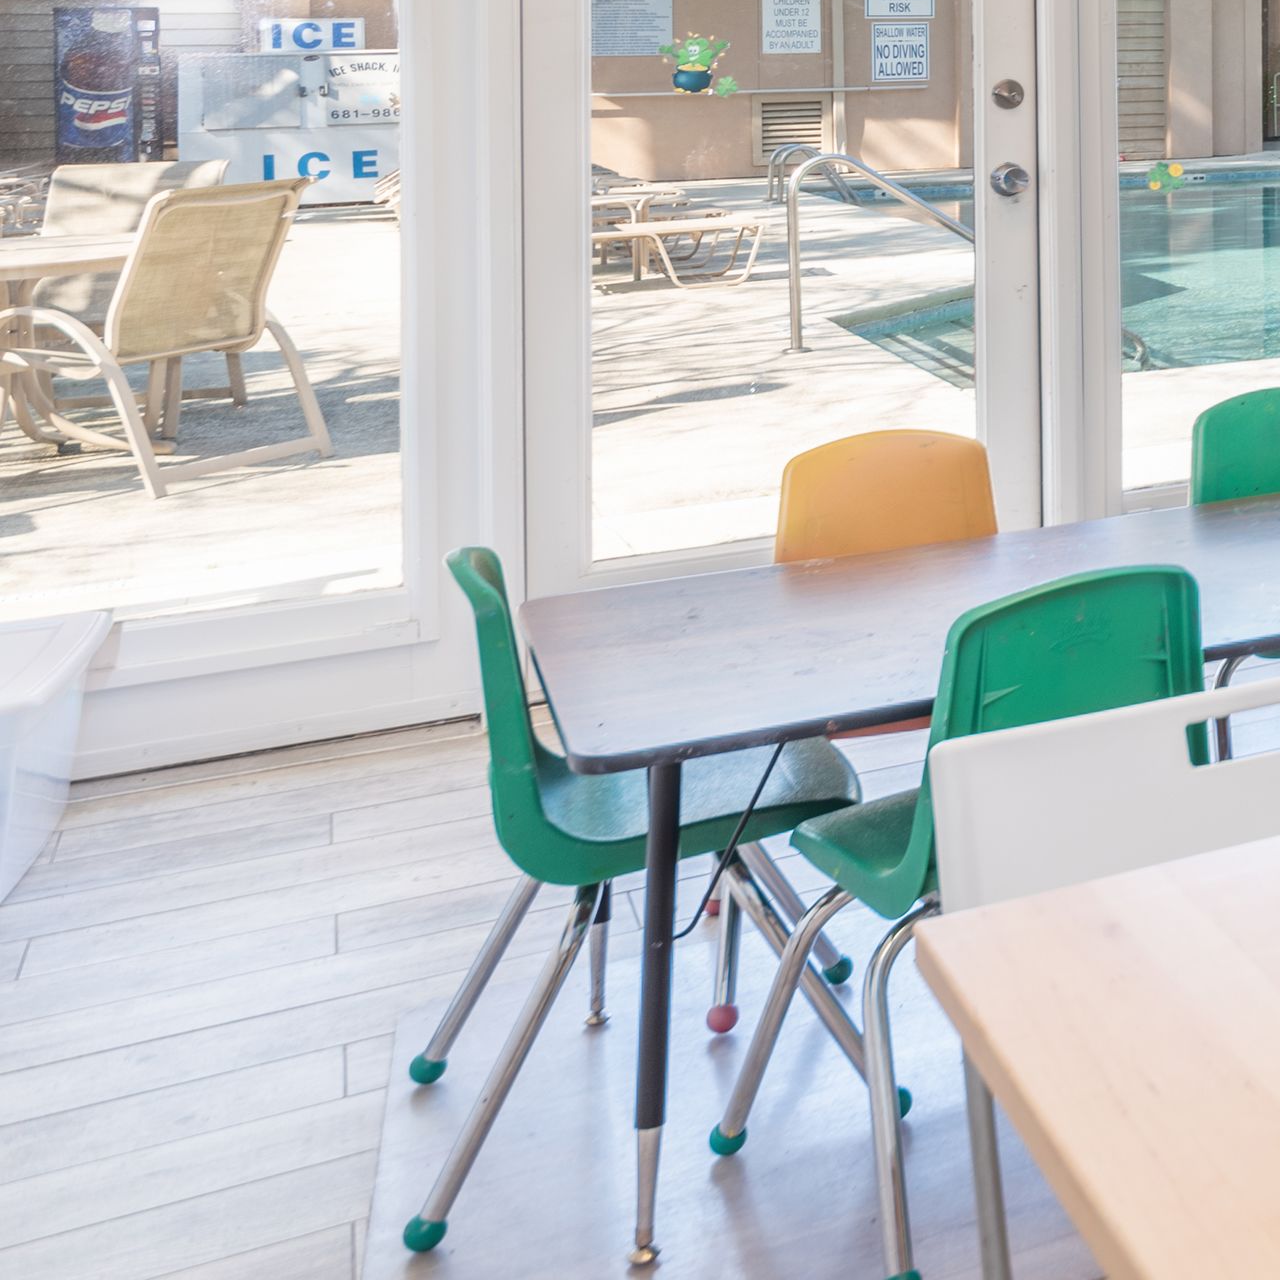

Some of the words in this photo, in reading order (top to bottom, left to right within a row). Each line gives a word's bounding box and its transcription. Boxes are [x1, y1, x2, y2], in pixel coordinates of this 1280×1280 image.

[774, 8, 799, 16] UNDER
[802, 8, 809, 16] 12
[889, 3, 911, 13] RISK
[776, 19, 796, 27] MUST
[798, 19, 807, 27] BE
[272, 22, 356, 49] ICE
[766, 30, 818, 38] ACCOMPANIED
[876, 28, 904, 38] SHALLOW
[906, 27, 925, 37] WATER
[769, 41, 779, 49] BY
[780, 41, 790, 49] AN
[792, 41, 814, 49] ADULT
[877, 45, 890, 59] NO
[893, 44, 925, 59] DIVING
[328, 66, 346, 77] ICE
[878, 61, 924, 76] ALLOWED
[60, 91, 131, 114] PEPSI
[263, 150, 378, 181] ICE
